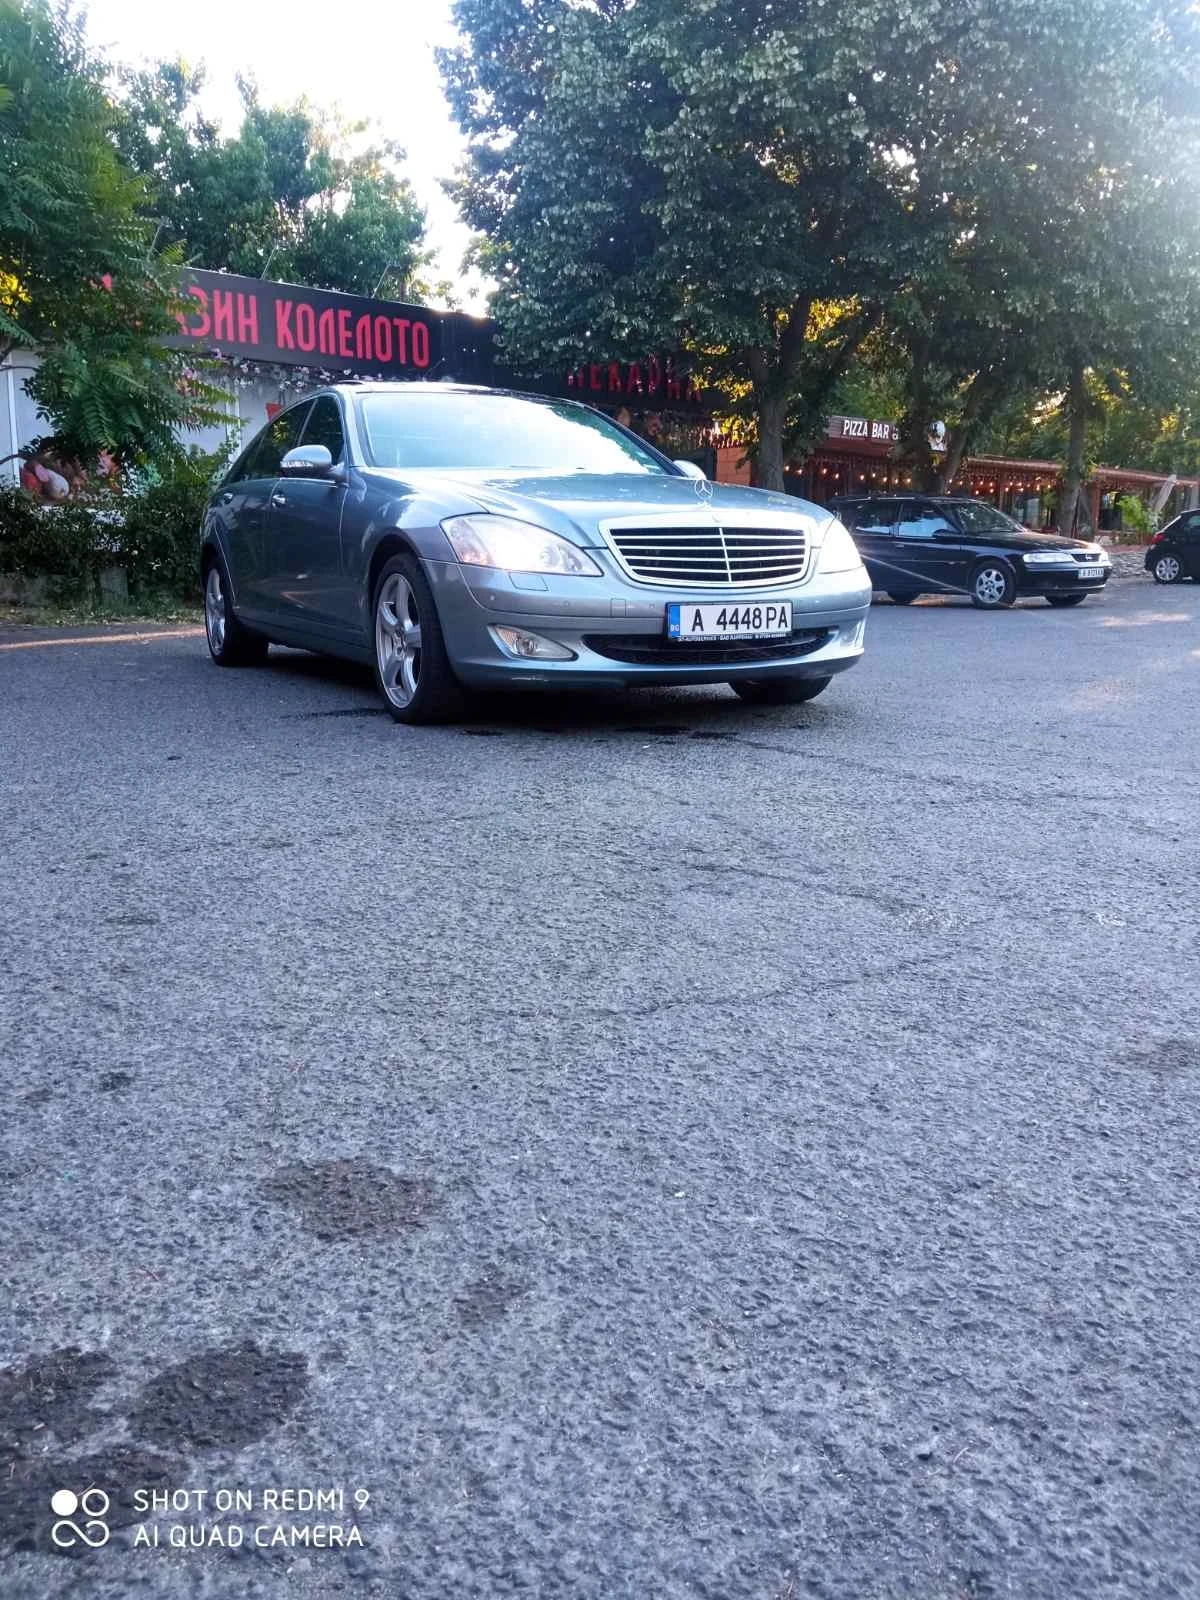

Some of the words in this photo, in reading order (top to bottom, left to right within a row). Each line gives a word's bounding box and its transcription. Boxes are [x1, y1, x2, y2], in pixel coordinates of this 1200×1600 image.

[275, 299, 429, 369] КОЛЕЛОТО
[842, 420, 868, 436] PIZZA
[872, 422, 890, 439] BAR
[691, 608, 705, 632] A
